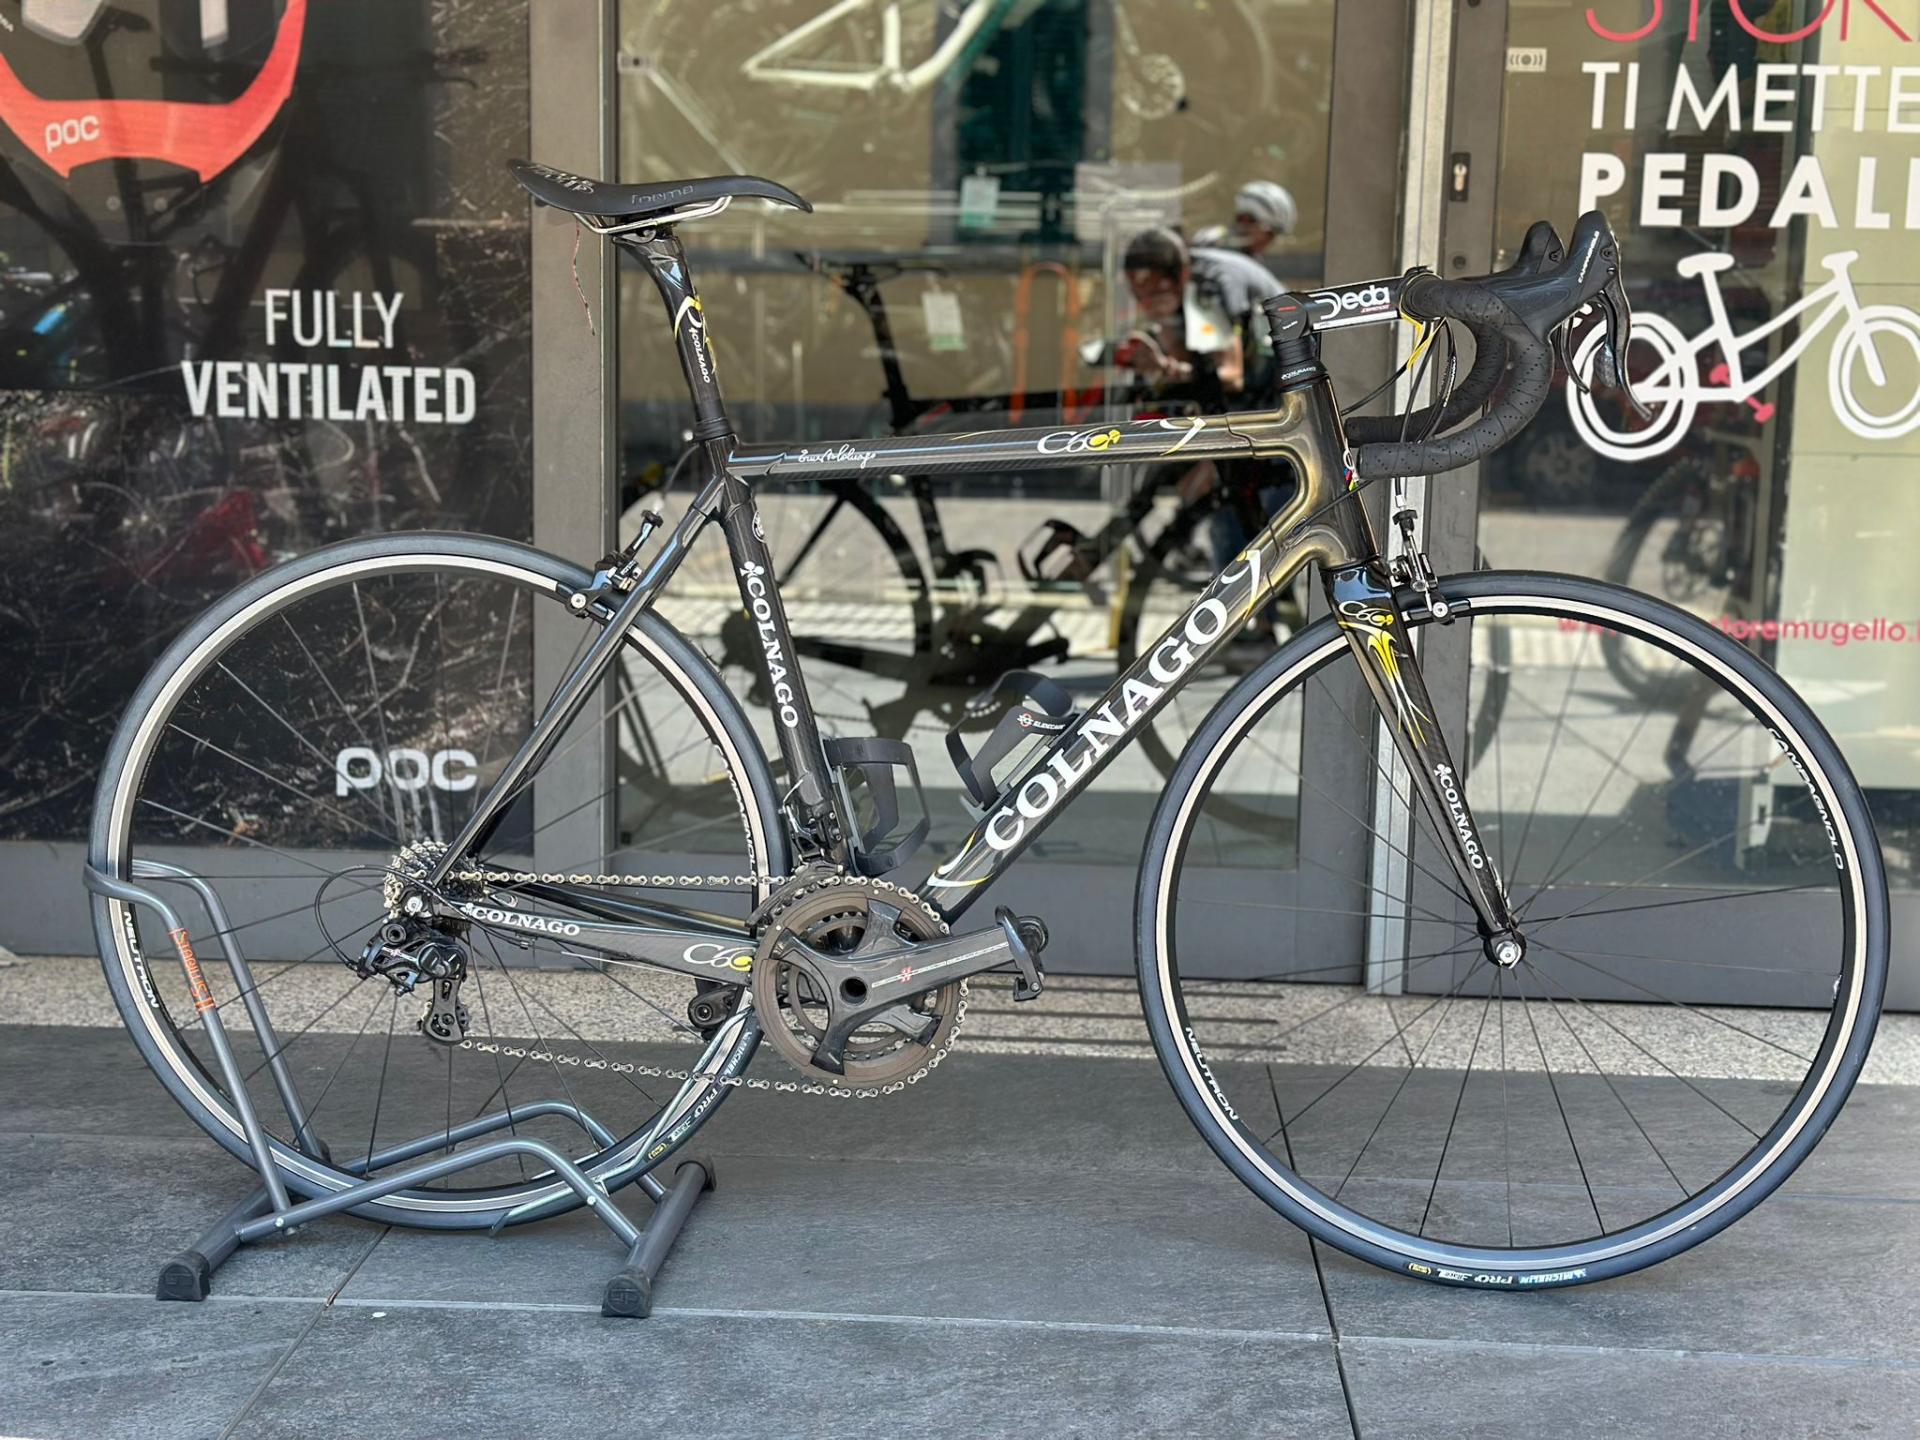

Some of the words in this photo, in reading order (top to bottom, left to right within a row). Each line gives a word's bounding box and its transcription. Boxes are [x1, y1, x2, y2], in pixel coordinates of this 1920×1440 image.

[1582, 62, 1640, 130] TI
[1666, 62, 1920, 132] METTE
[265, 288, 404, 349] FULLY
[690, 332, 711, 384] COLNAGO
[180, 360, 477, 424] VENTILATED
[746, 575, 799, 729] COLNAGO
[984, 597, 1228, 851] COLNAGO
[1440, 774, 1484, 870] COLNAGO
[1768, 727, 1844, 870] CAMPAGNOLO
[123, 911, 160, 1008] NEUTRON
[471, 907, 581, 936] COLNAGO
[1186, 1027, 1239, 1120] NEUTRON
